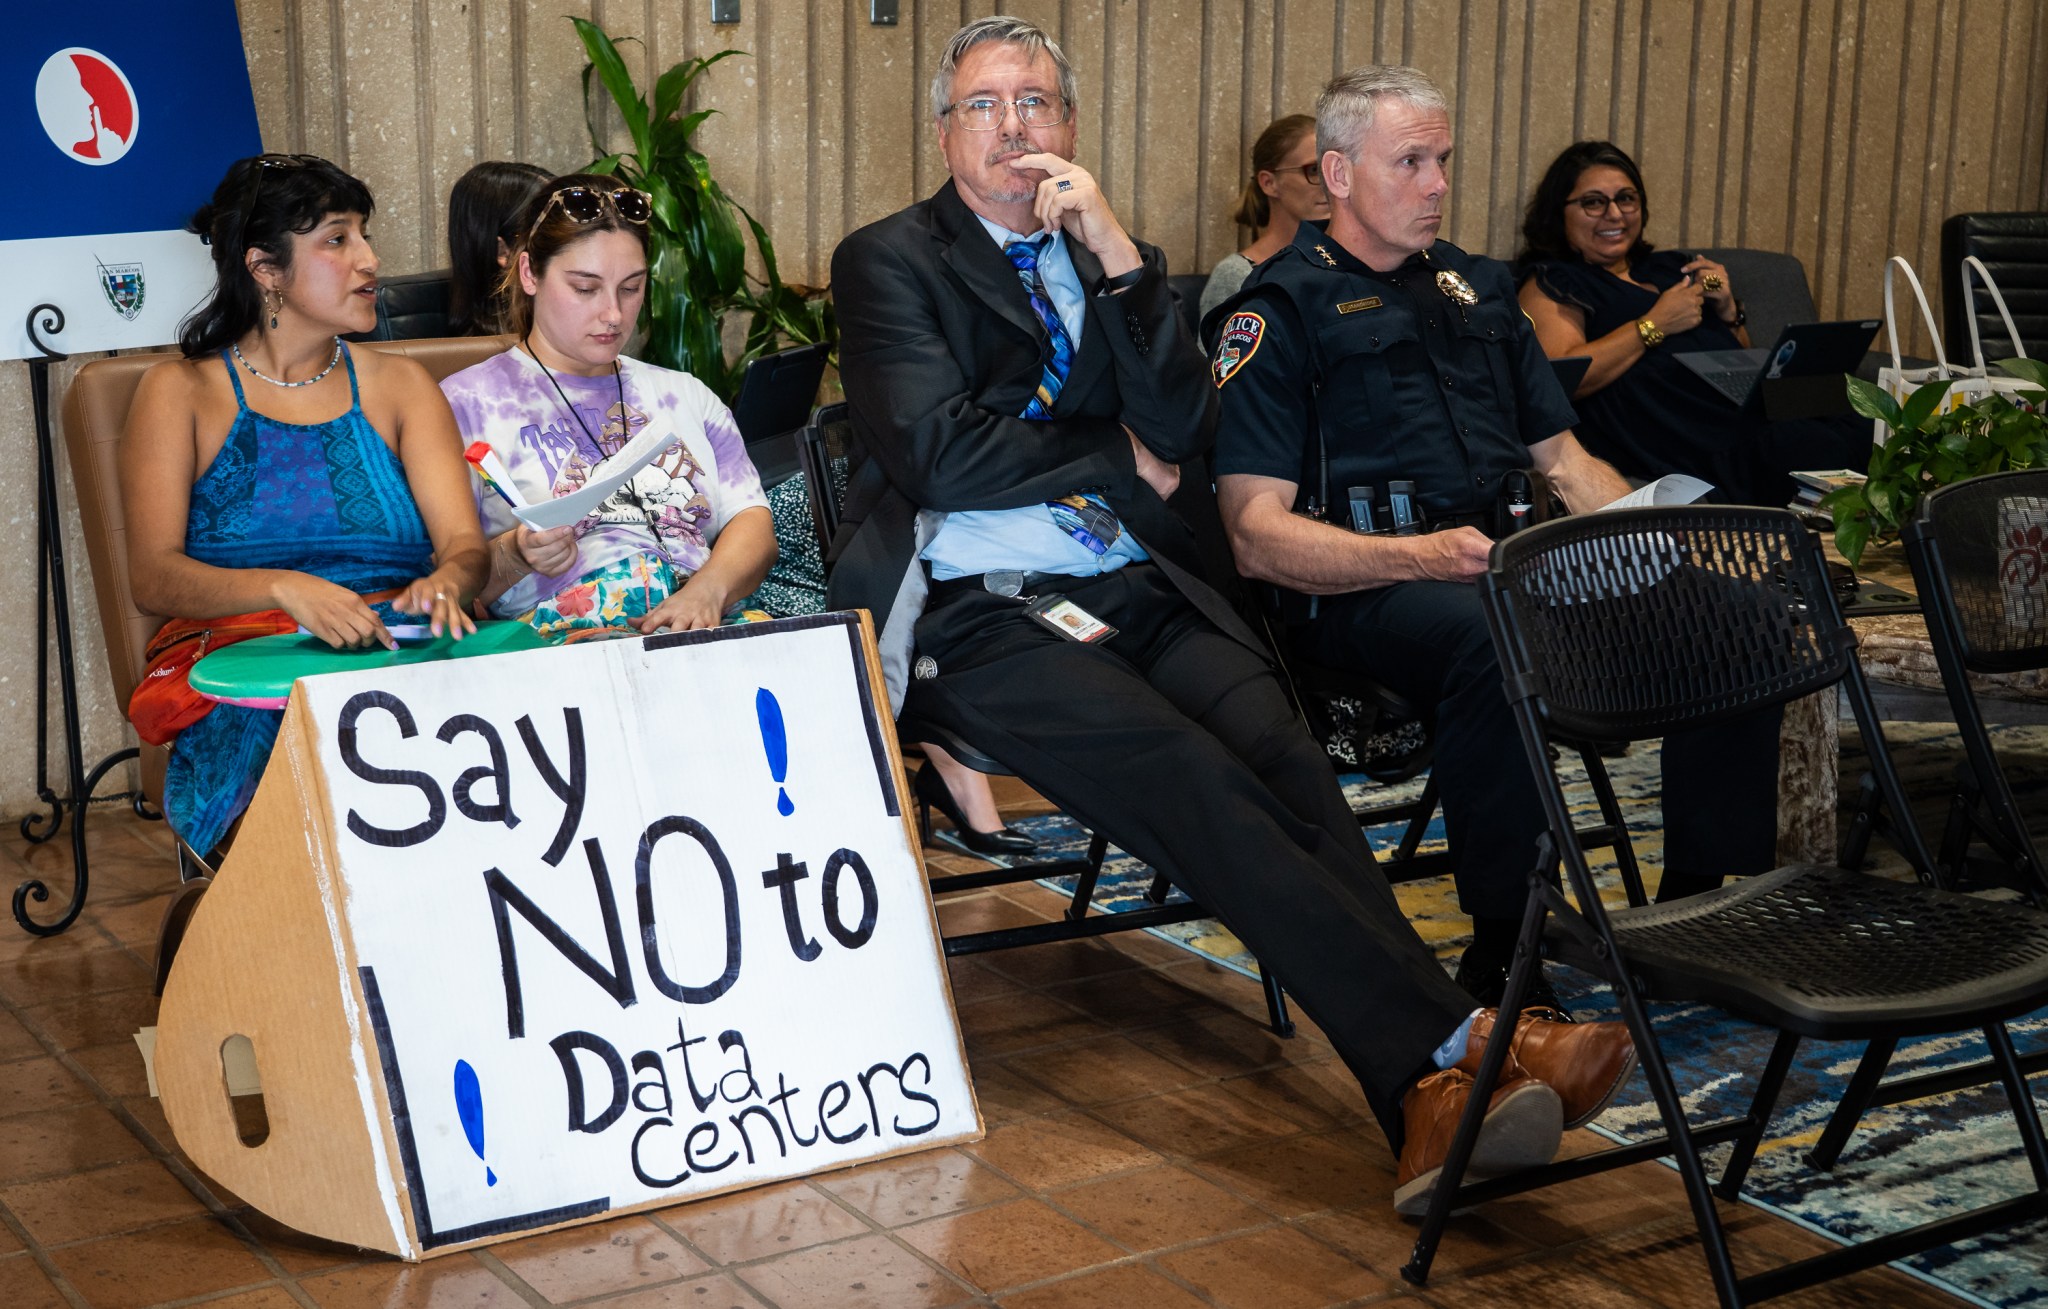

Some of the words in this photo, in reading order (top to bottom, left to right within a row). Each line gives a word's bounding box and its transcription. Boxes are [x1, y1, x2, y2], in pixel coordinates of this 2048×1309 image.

[337, 690, 587, 868] Say
[483, 815, 742, 1040] NO
[761, 847, 879, 962] to
[549, 1017, 763, 1134] Data
